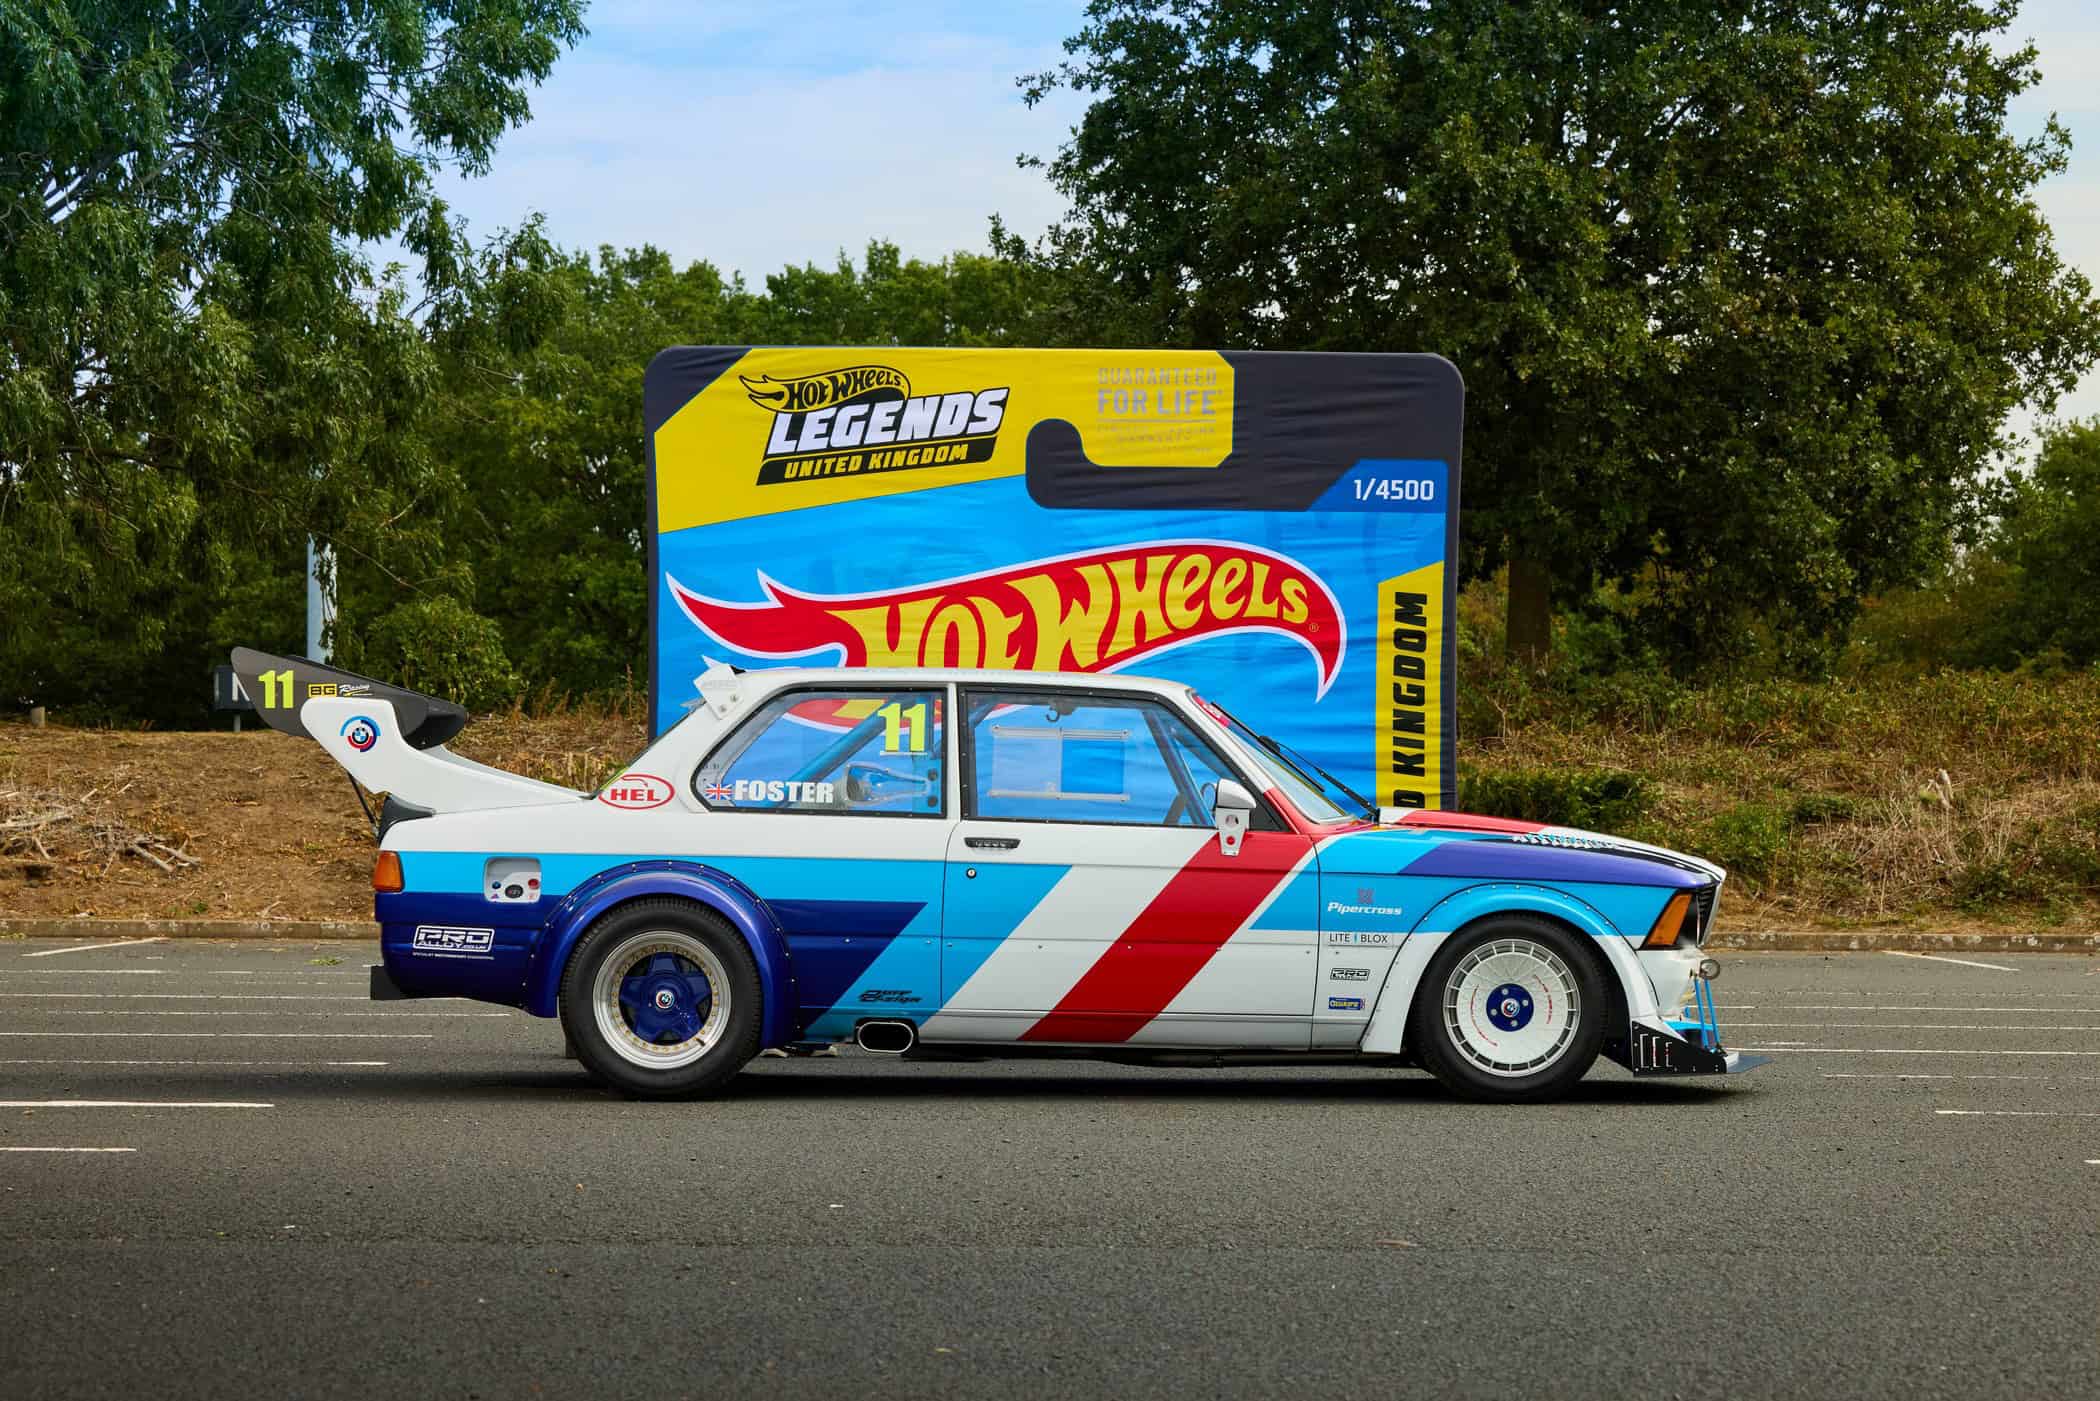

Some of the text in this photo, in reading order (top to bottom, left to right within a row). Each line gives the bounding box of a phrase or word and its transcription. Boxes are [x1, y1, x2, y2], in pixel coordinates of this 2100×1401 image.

[1098, 368, 1217, 386] GUARANTEED
[1097, 389, 1217, 415] FOR LIFE
[766, 388, 1009, 455] LEGENDS
[784, 443, 969, 479] UNITED KINGDOM
[1353, 479, 1434, 502] 1/4500
[258, 670, 294, 709] 11
[310, 685, 336, 696] BG
[1392, 591, 1428, 777] KINGDOM
[877, 703, 926, 752] 11
[610, 788, 661, 801] HEL
[733, 779, 834, 804] FOSTER
[1327, 902, 1402, 916] Pipercross
[418, 928, 491, 944] PRO
[1329, 933, 1389, 943] LITE BLOX
